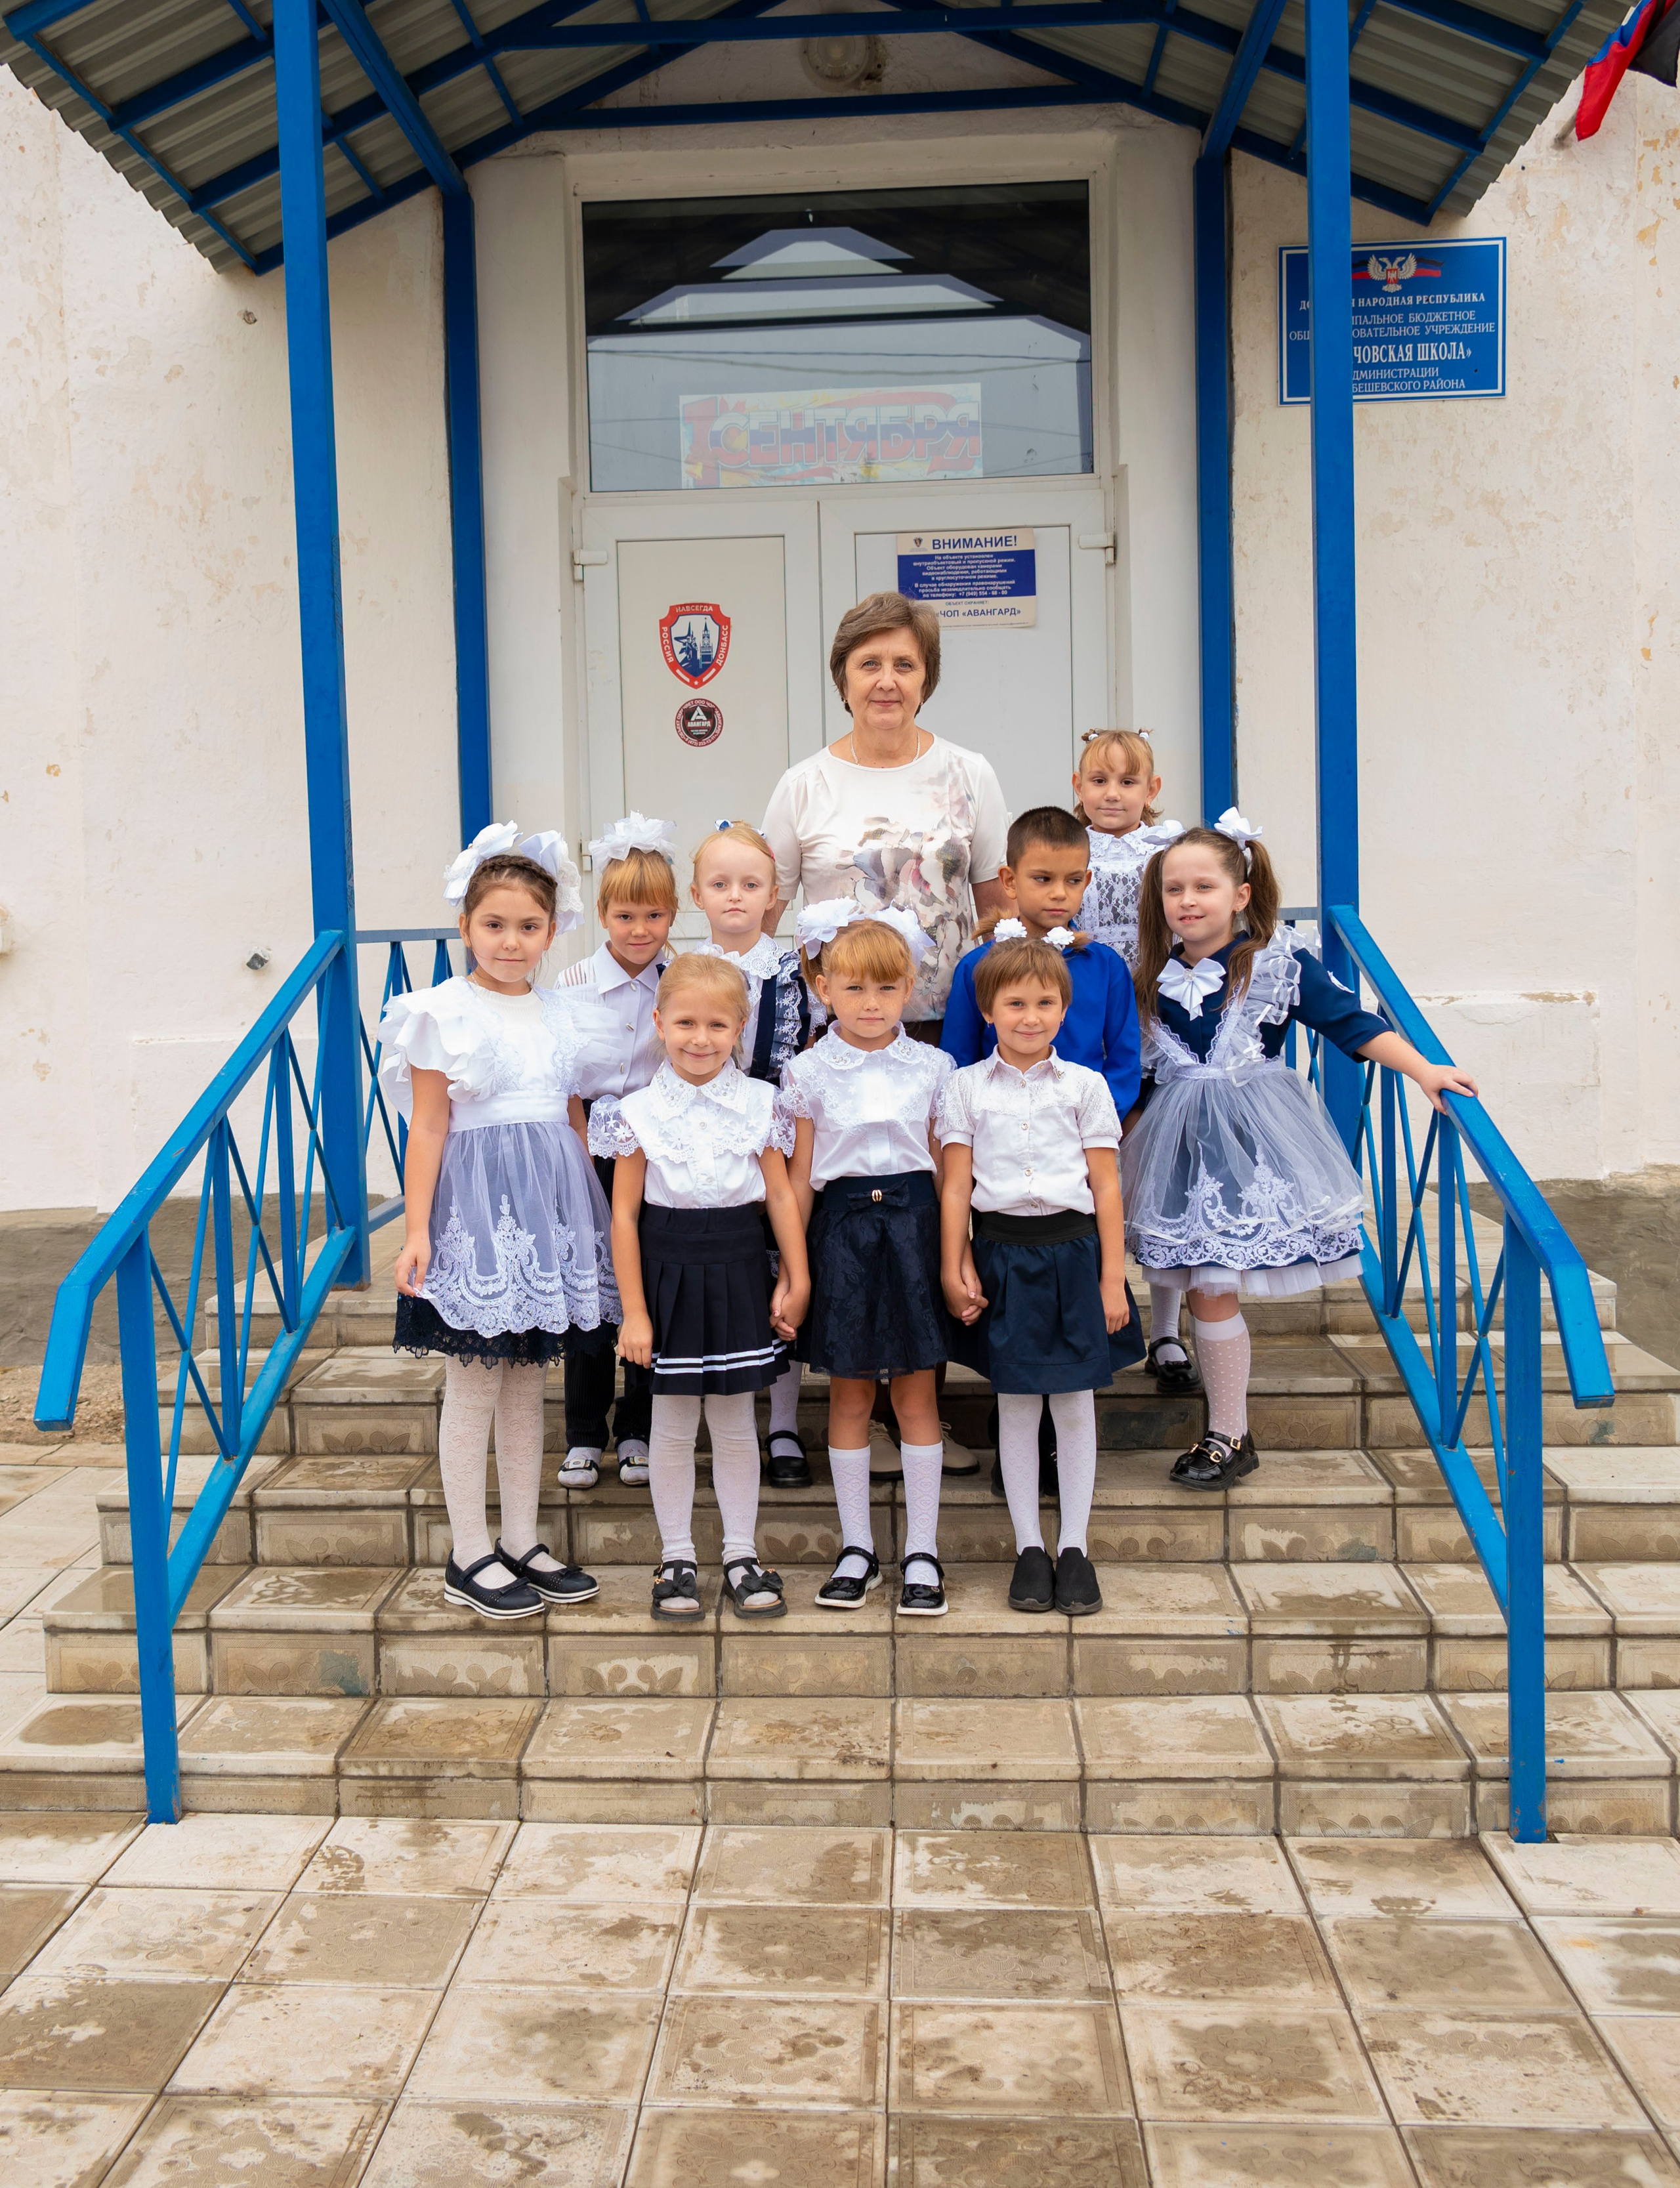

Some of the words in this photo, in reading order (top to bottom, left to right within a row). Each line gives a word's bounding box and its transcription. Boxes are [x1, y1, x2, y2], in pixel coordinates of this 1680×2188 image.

[1358, 297, 1413, 307] НАРОДНАЯ
[1416, 293, 1485, 305] РЕСПУБЛИКА
[1352, 314, 1404, 326] ПАЛЬНОЕ
[1409, 310, 1476, 324] БЮДЖЕТНОЕ
[1425, 323, 1495, 335] УЧРЕЖДЕНИЕ
[1353, 344, 1413, 364] ЧОВСКАЯ
[1417, 341, 1472, 361] ШКОЛА»
[1353, 367, 1438, 381] ДМИНИСТРАЦИИ
[1352, 381, 1421, 393] БЕШЕВСКОГО
[1423, 378, 1465, 390] РАЙОНА
[682, 396, 721, 486] 1
[708, 401, 982, 468] СЕНТЯБРЯ
[933, 536, 1017, 550] ВНИМАНИЕ!
[962, 608, 1021, 618] «АВАНГАРД»
[662, 627, 674, 663] РОССИЯ
[716, 625, 728, 666] ДОНБАСС
